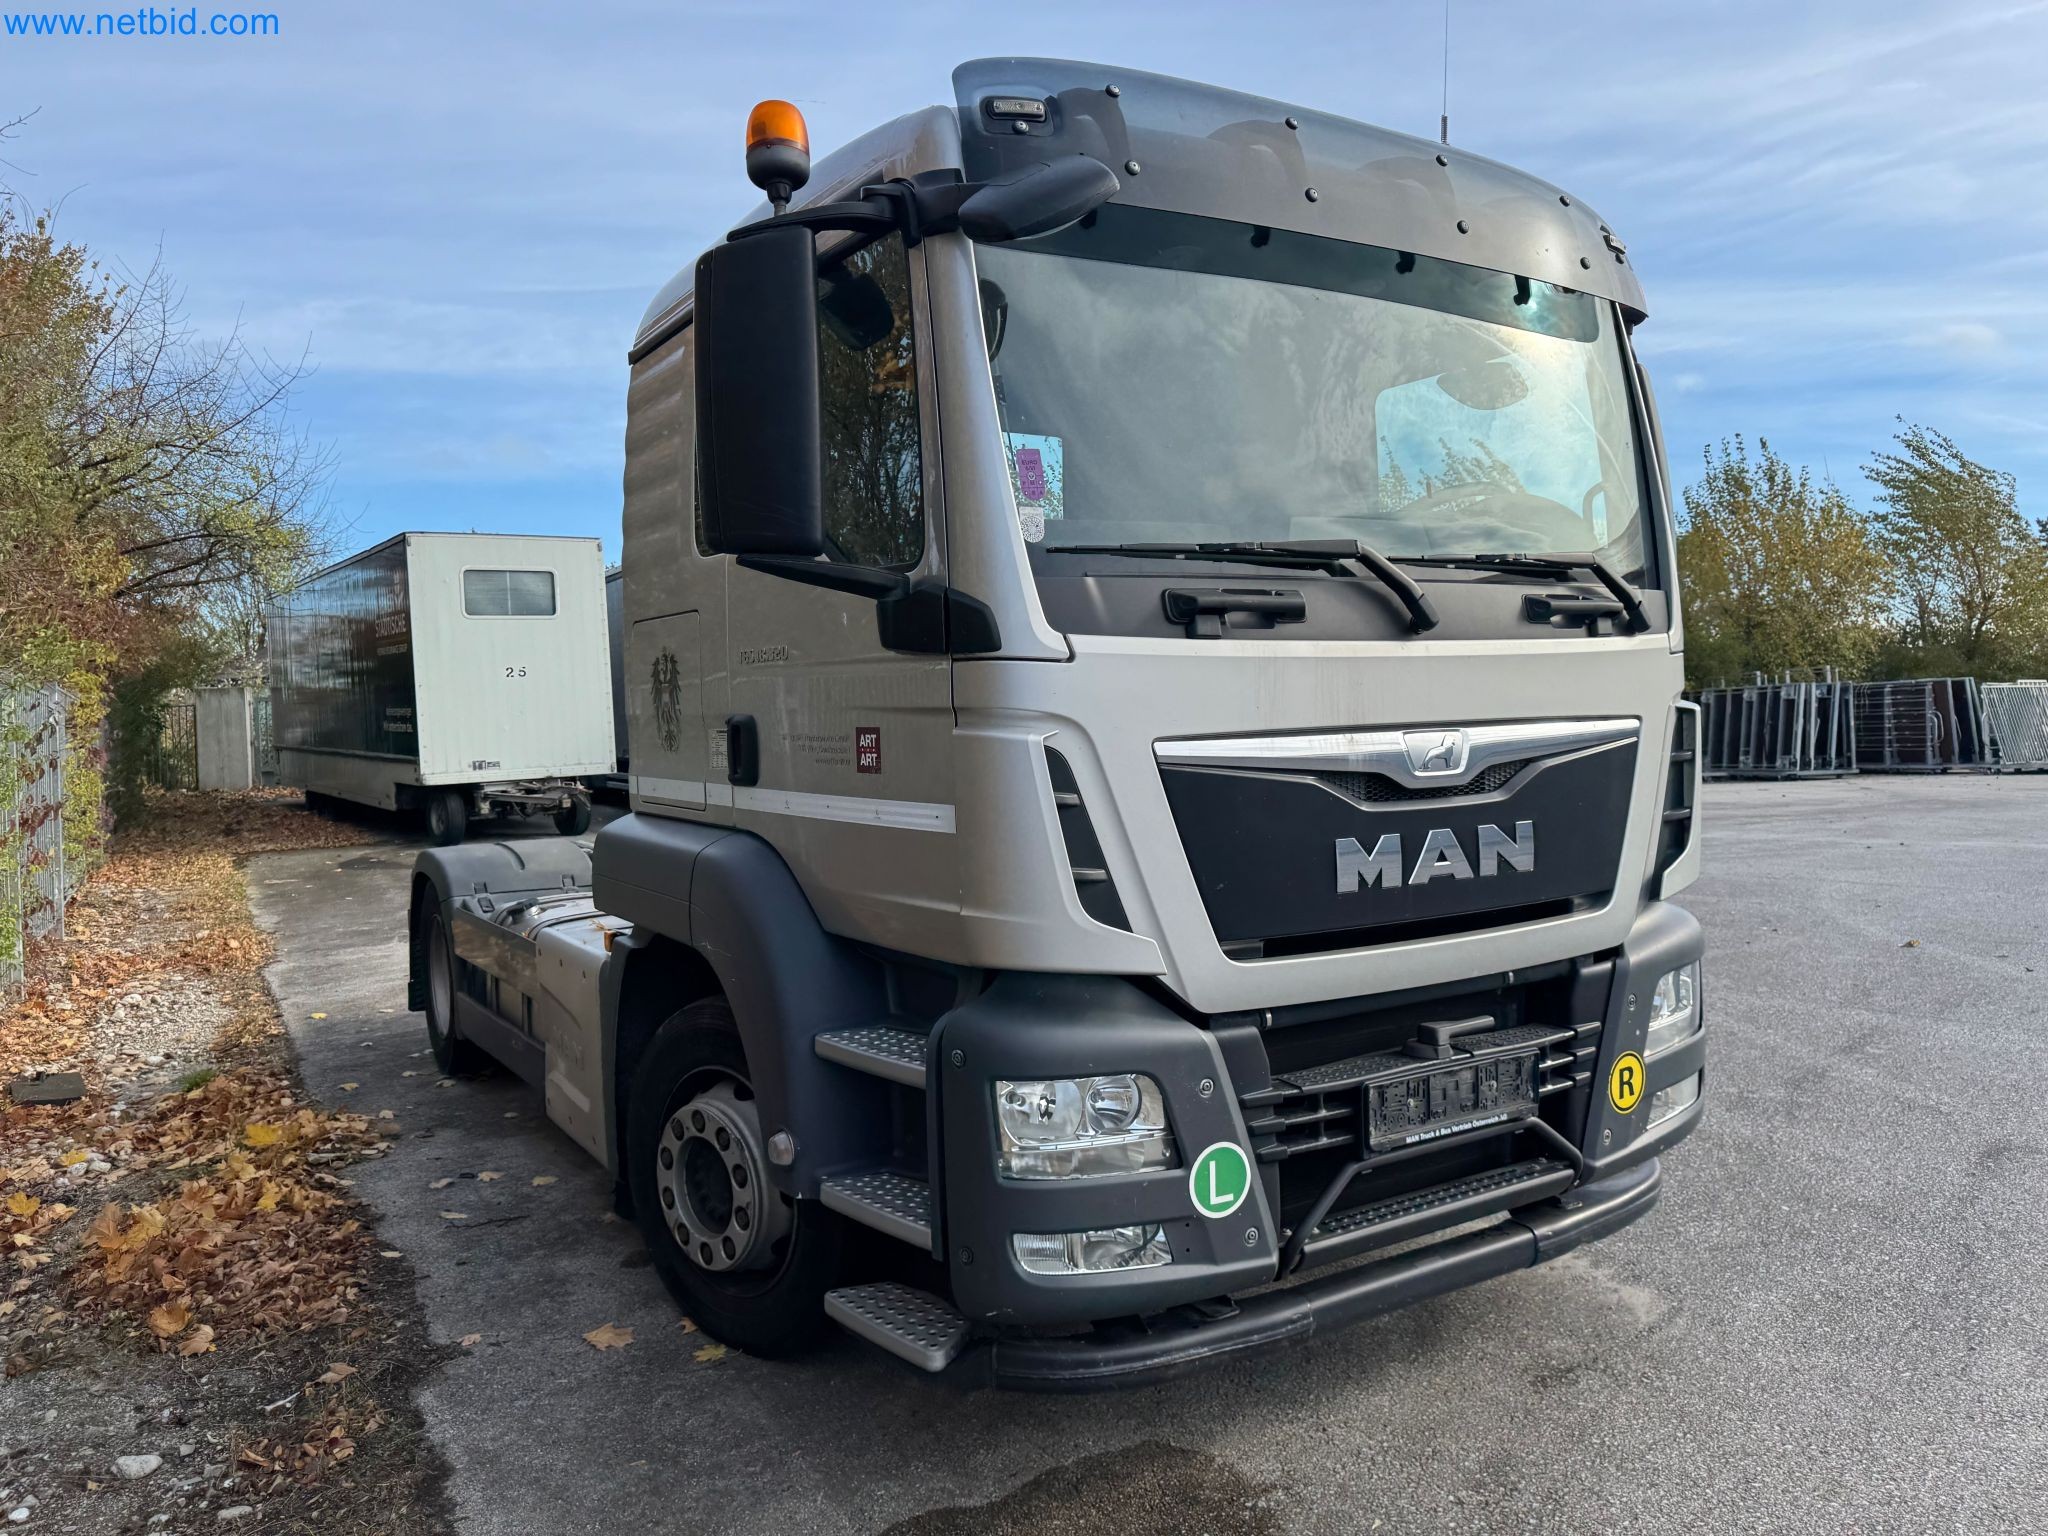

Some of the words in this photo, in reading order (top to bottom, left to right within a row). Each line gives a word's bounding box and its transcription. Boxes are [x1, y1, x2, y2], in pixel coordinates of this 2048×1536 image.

[859, 733, 877, 748] ART
[860, 753, 878, 767] ART
[1335, 820, 1535, 894] MAN
[1618, 1065, 1635, 1100] R
[1405, 1134, 1420, 1144] MAN
[1420, 1131, 1435, 1140] Truck
[1440, 1127, 1452, 1135] Bus
[1208, 1160, 1235, 1206] L
